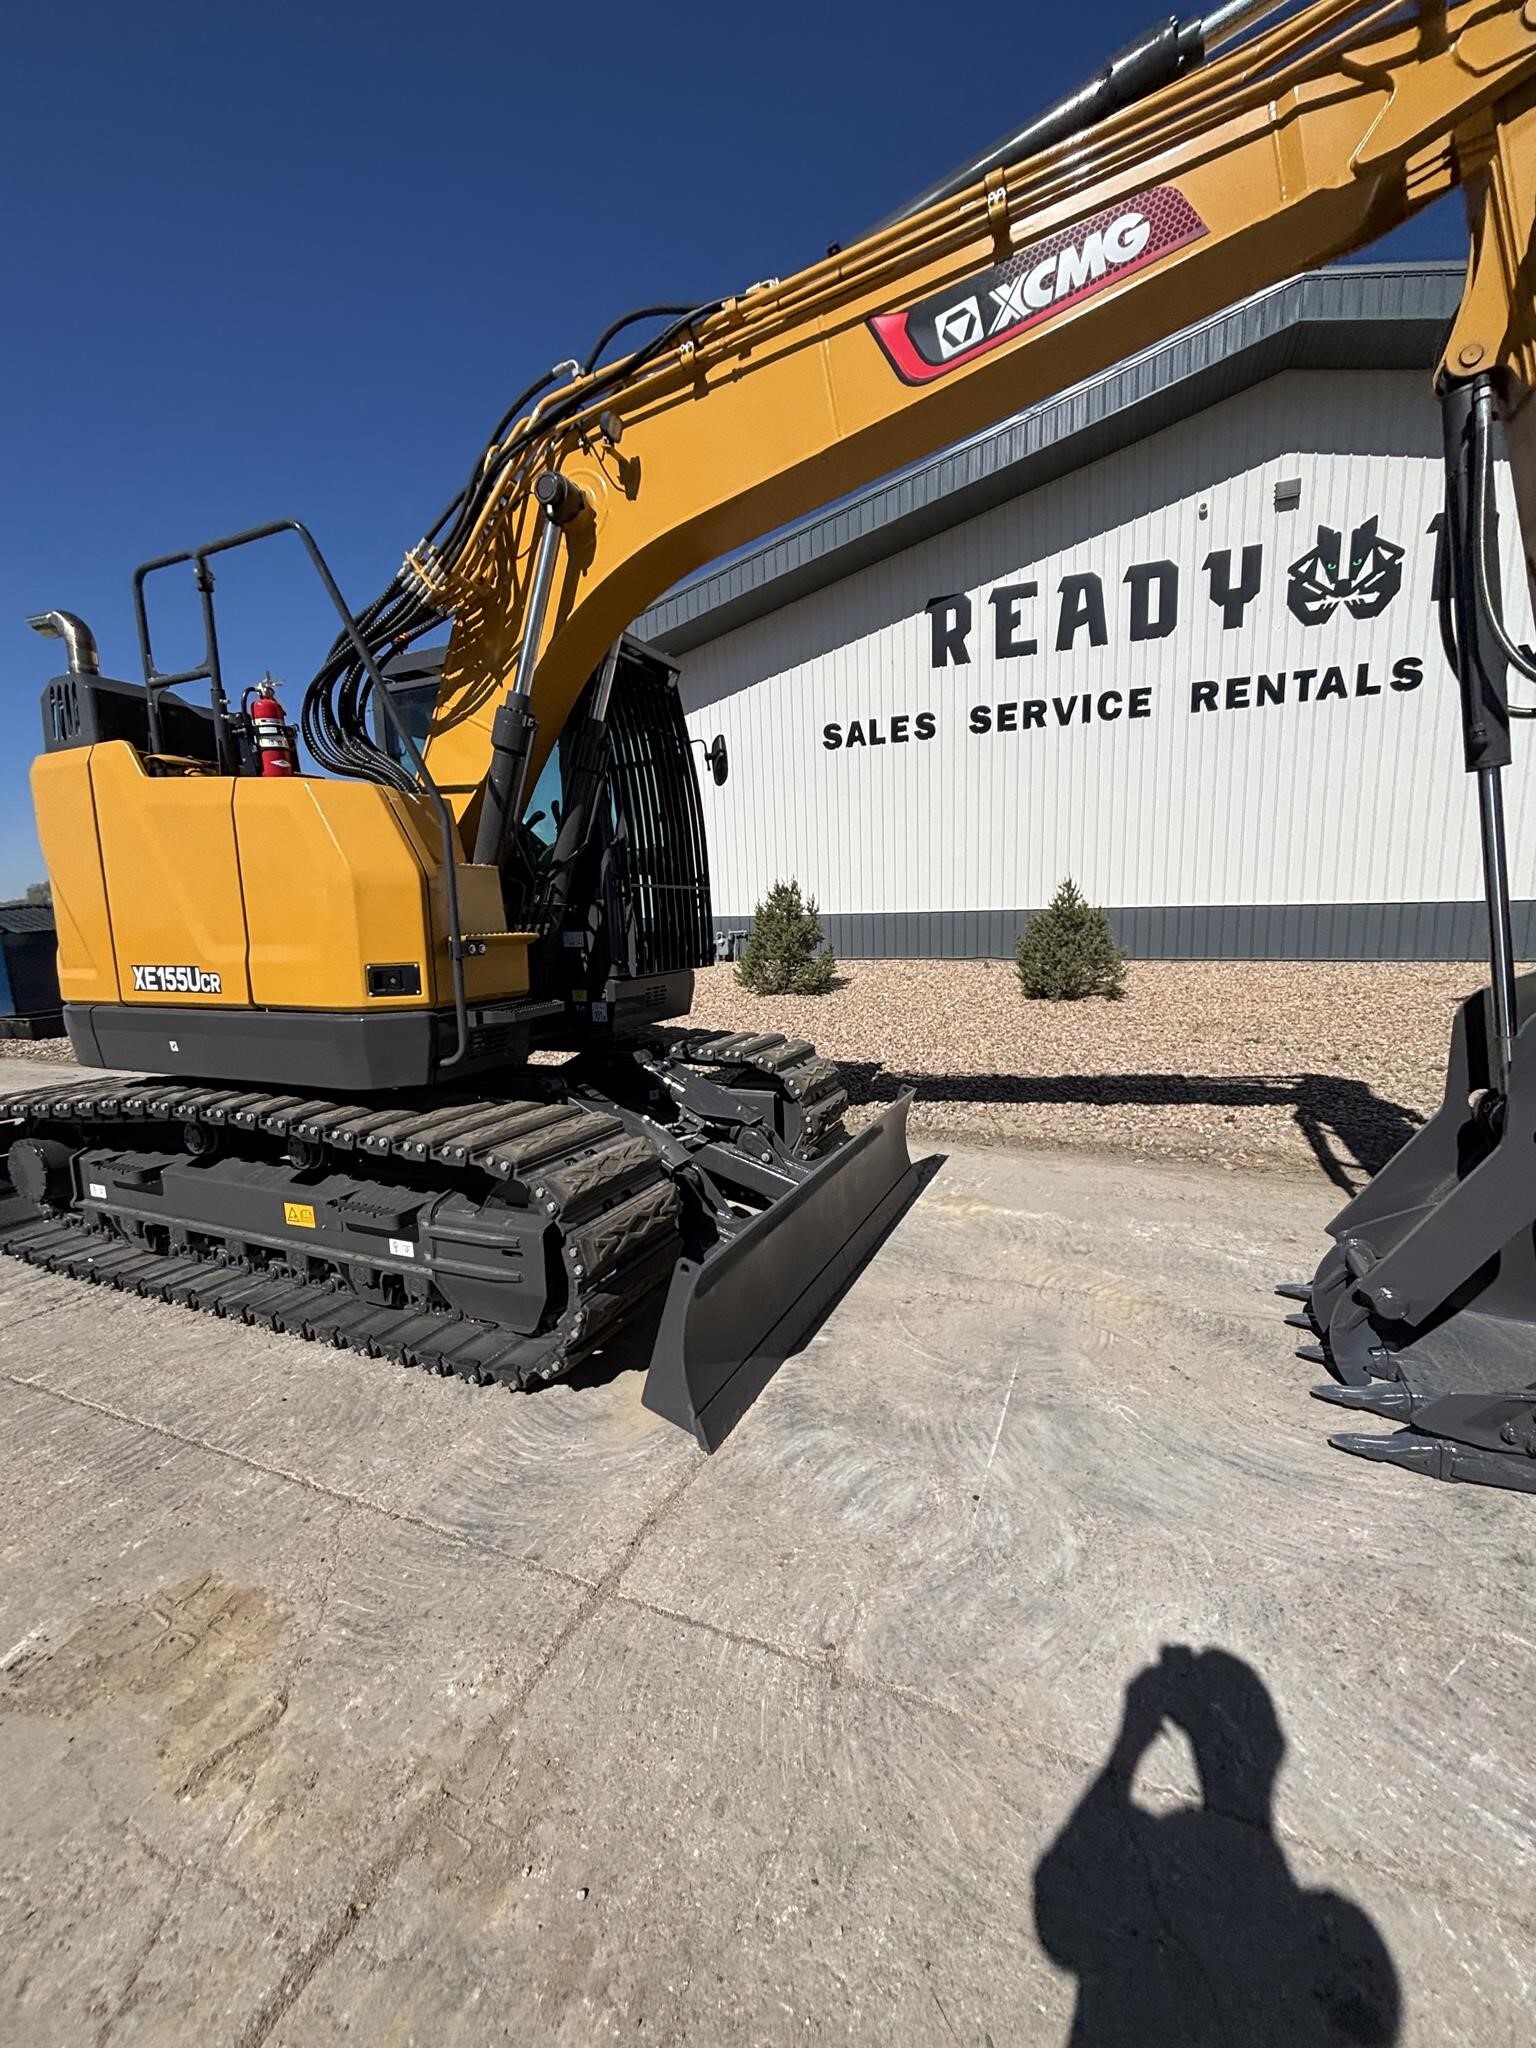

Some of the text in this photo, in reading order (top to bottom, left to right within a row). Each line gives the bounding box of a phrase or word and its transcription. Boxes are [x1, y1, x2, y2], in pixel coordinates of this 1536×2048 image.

[987, 212, 1151, 335] XCMG
[924, 543, 1263, 669] READY
[822, 656, 1424, 751] SALES SERVICE RENTALS
[132, 966, 221, 992] XE155UCR
